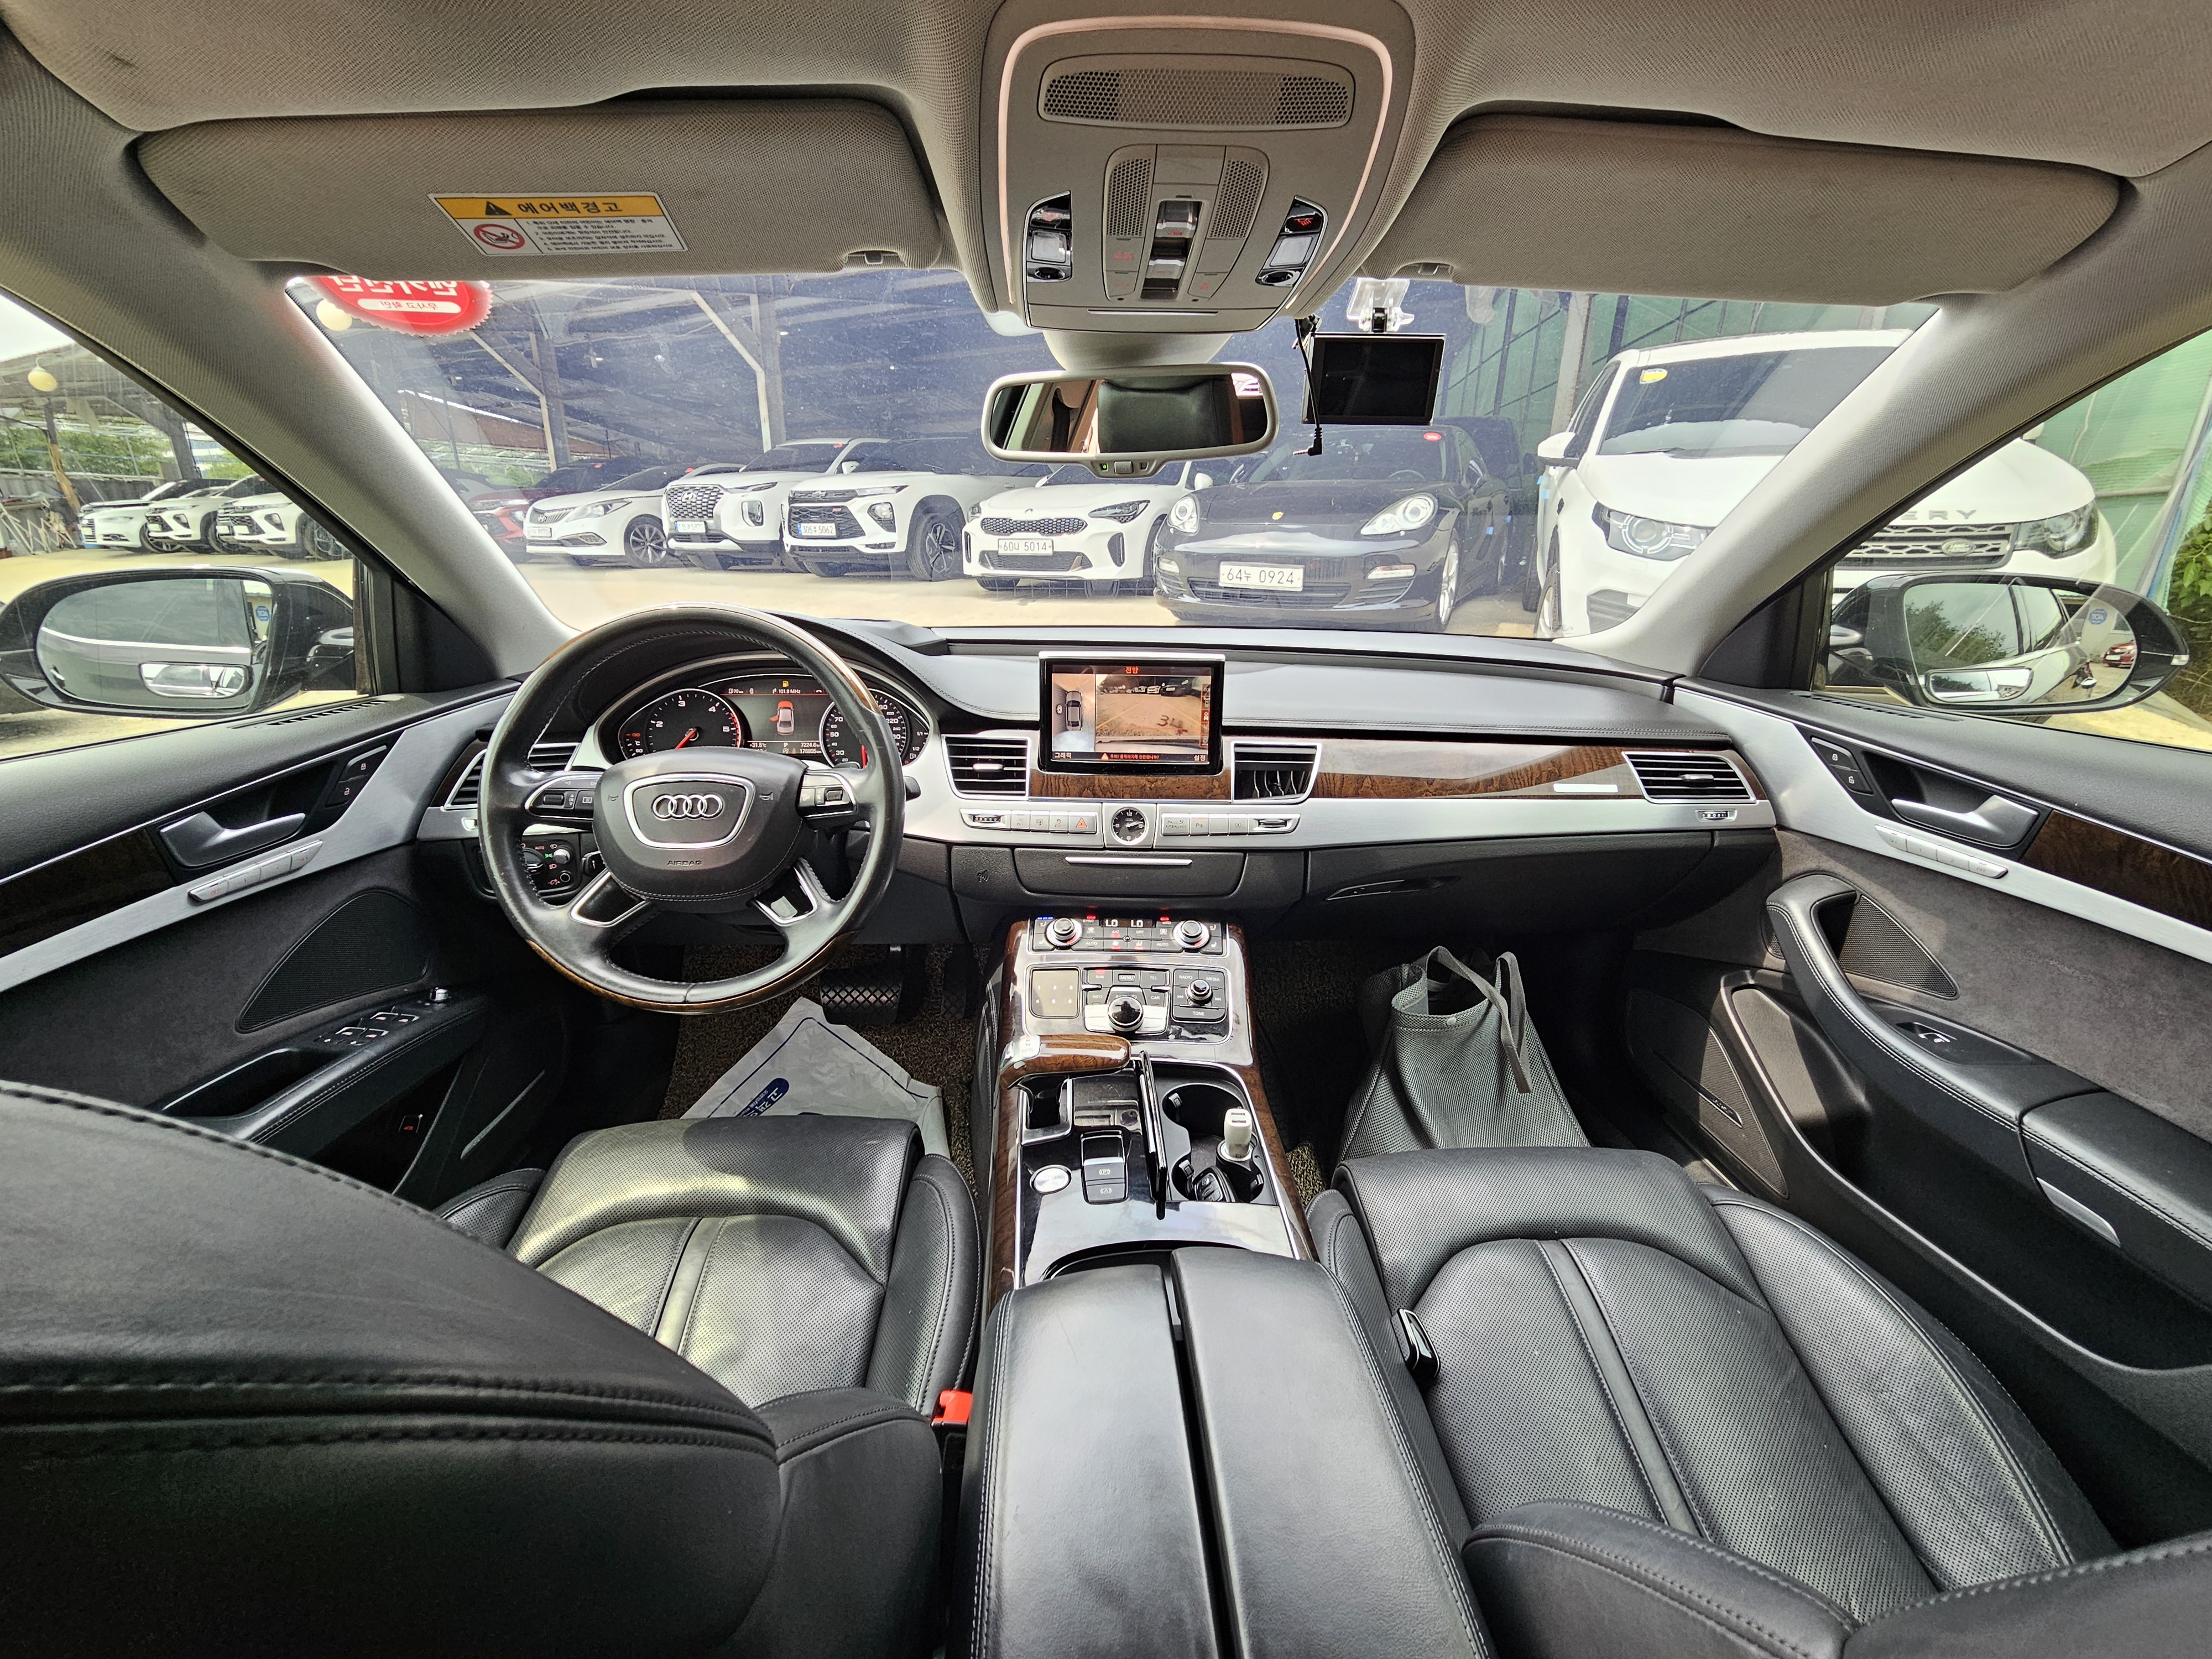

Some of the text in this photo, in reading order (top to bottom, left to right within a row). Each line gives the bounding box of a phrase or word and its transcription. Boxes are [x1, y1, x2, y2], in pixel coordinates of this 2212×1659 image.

[517, 201, 623, 215] 에어백경고
[818, 525, 833, 534] 5062
[1024, 541, 1047, 551] 5014
[1227, 567, 1295, 585] 64누 0924
[1130, 919, 1144, 927] LO
